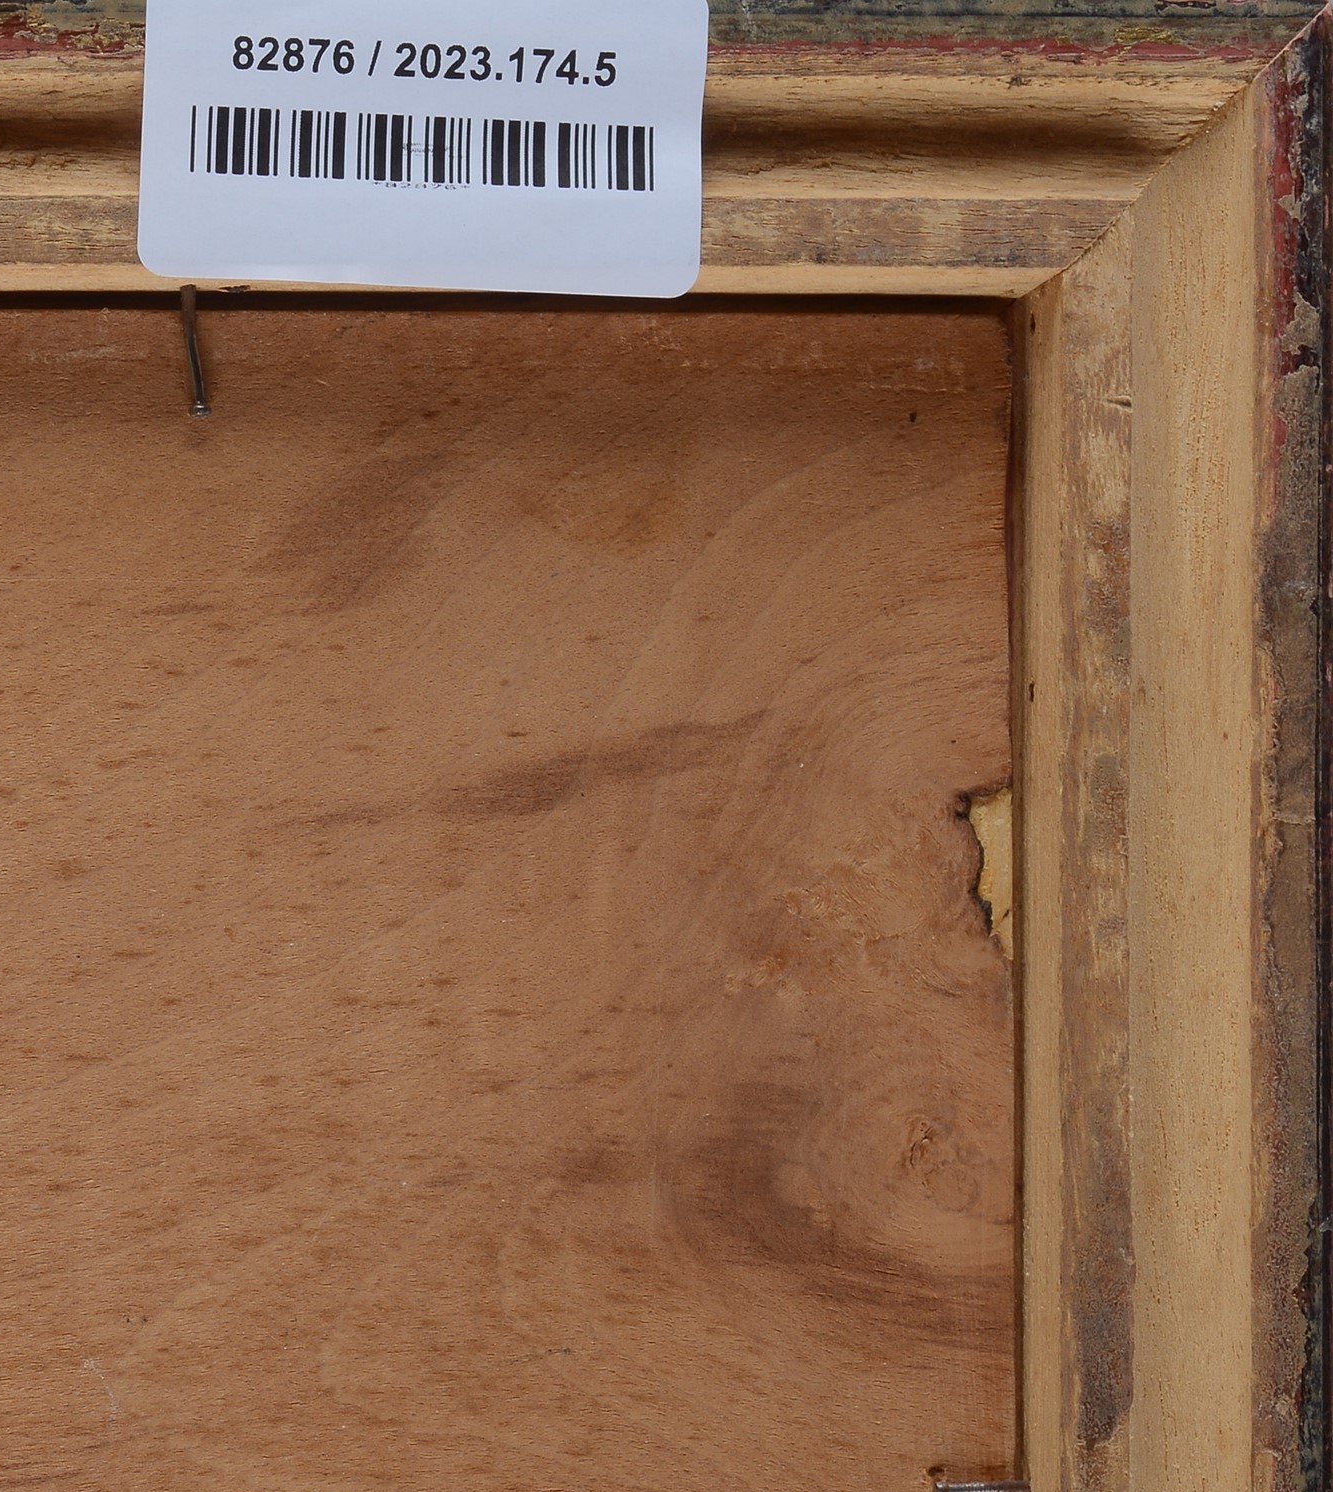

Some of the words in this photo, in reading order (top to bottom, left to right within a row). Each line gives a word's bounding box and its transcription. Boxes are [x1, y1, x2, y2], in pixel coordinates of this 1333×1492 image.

[232, 35, 355, 75] 82876
[367, 40, 382, 77] /
[393, 42, 617, 88] 2023.174.5
